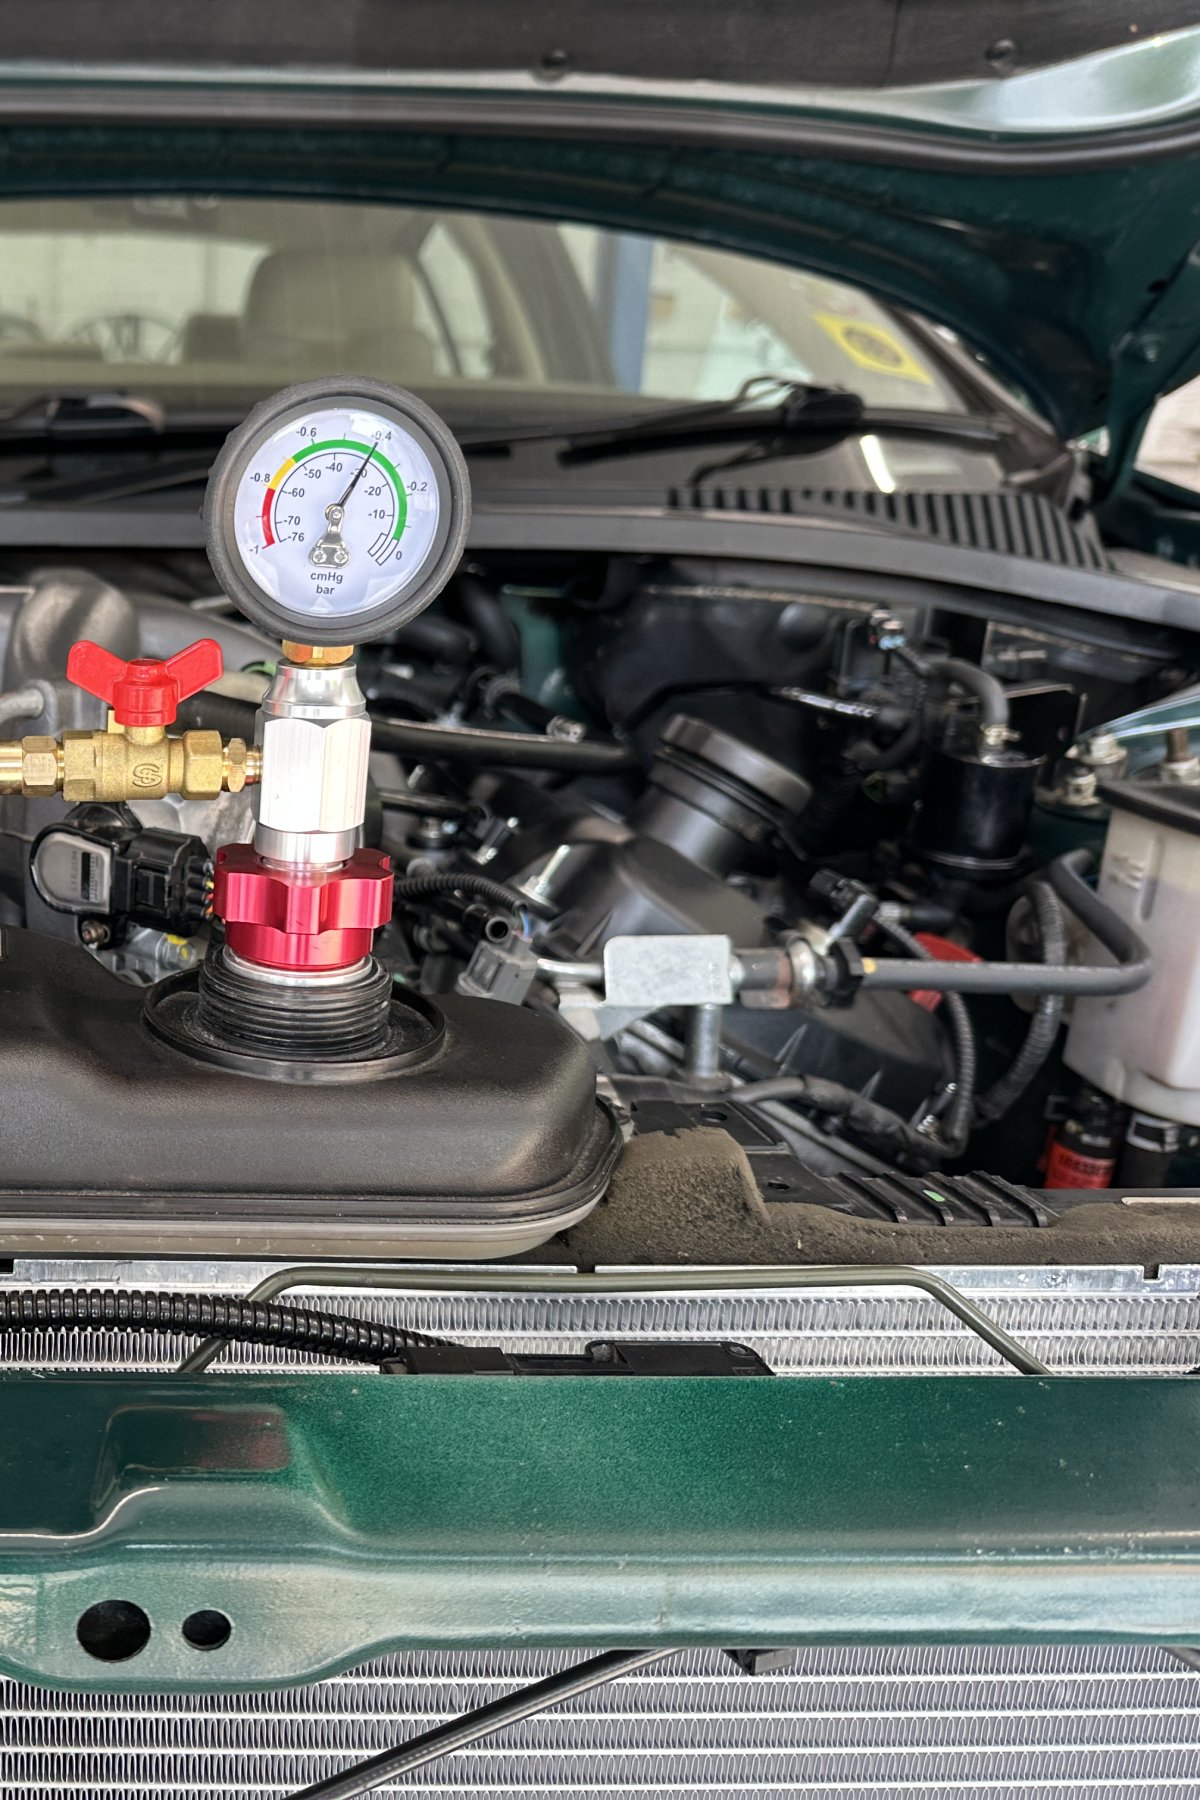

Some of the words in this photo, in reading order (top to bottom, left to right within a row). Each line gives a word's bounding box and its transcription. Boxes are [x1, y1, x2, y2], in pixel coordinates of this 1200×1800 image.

[296, 427, 317, 438] -0.6
[371, 431, 393, 441] -0.4
[325, 463, 343, 473] -40
[250, 472, 270, 483] -0.8
[304, 469, 321, 479] -50
[350, 468, 368, 479] -30
[364, 486, 382, 497] -20
[406, 481, 428, 492] -0.2
[287, 488, 305, 498] -60
[368, 510, 386, 520] -10
[283, 516, 301, 526] -70
[287, 532, 305, 542] -76
[249, 545, 260, 555] -1
[395, 551, 402, 561] 0
[310, 572, 344, 584] cmHg
[315, 585, 335, 596] bar
